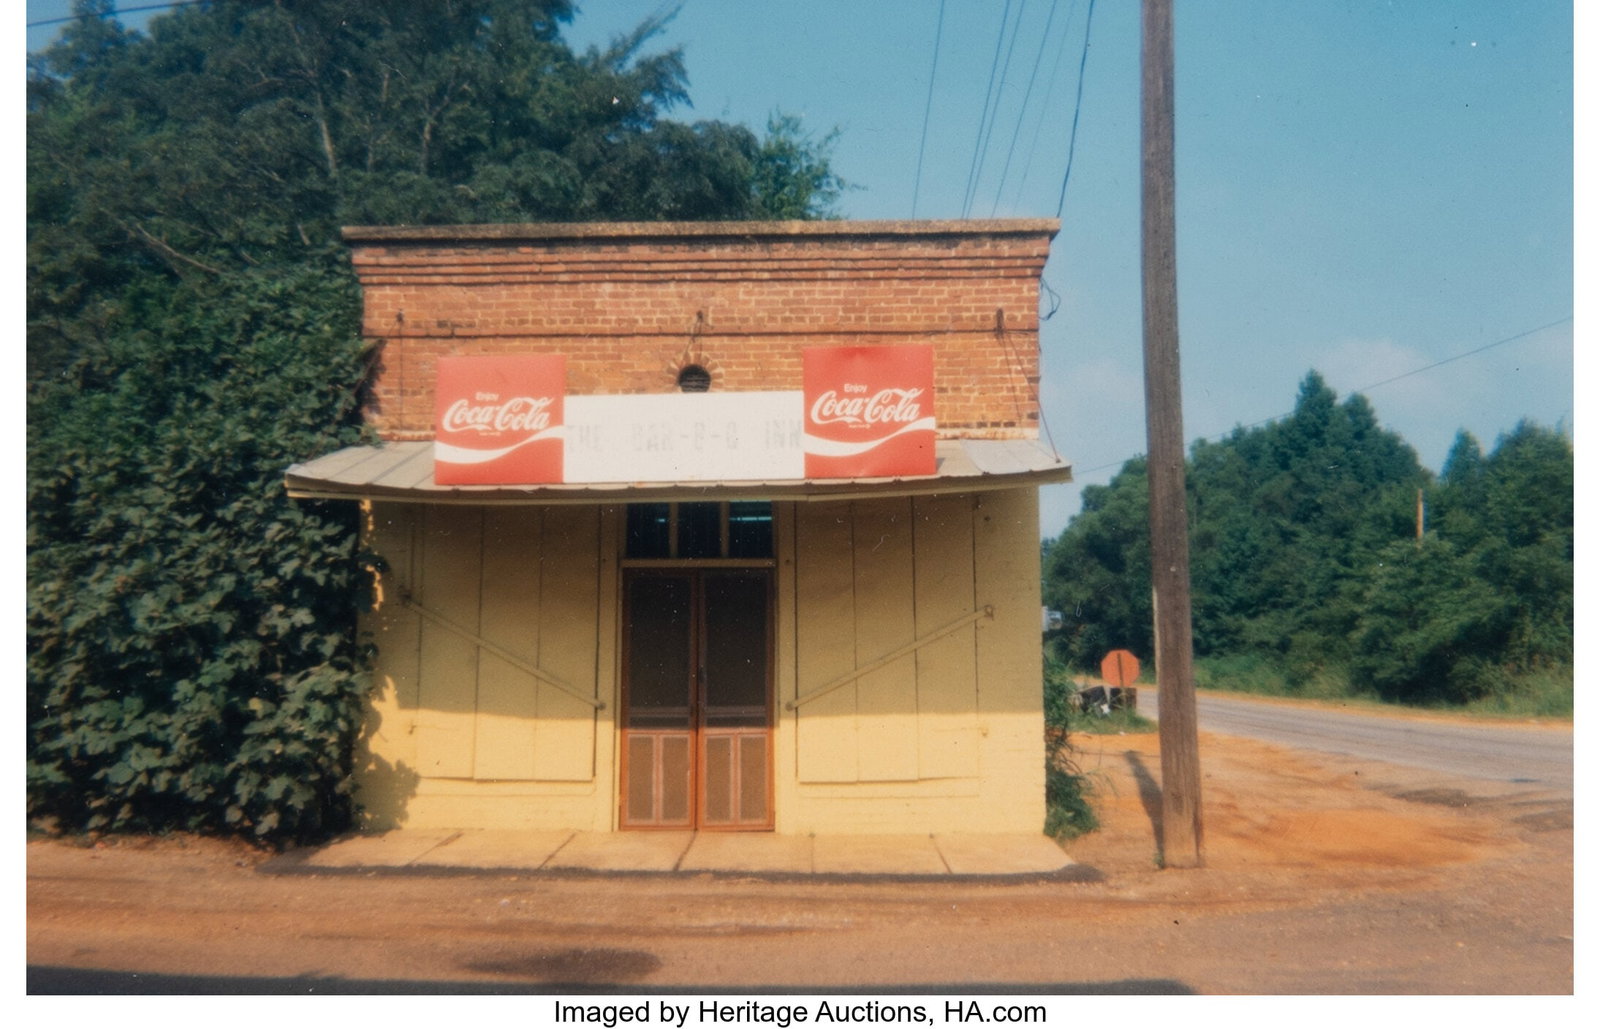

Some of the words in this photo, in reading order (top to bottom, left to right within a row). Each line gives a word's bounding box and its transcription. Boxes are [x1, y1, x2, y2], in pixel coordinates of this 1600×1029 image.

[475, 392, 500, 402] Enjoy
[844, 383, 868, 394] Enjoy
[442, 397, 554, 433] Coca-Cola
[810, 388, 925, 425] Coca-Cola
[764, 418, 802, 450] INN
